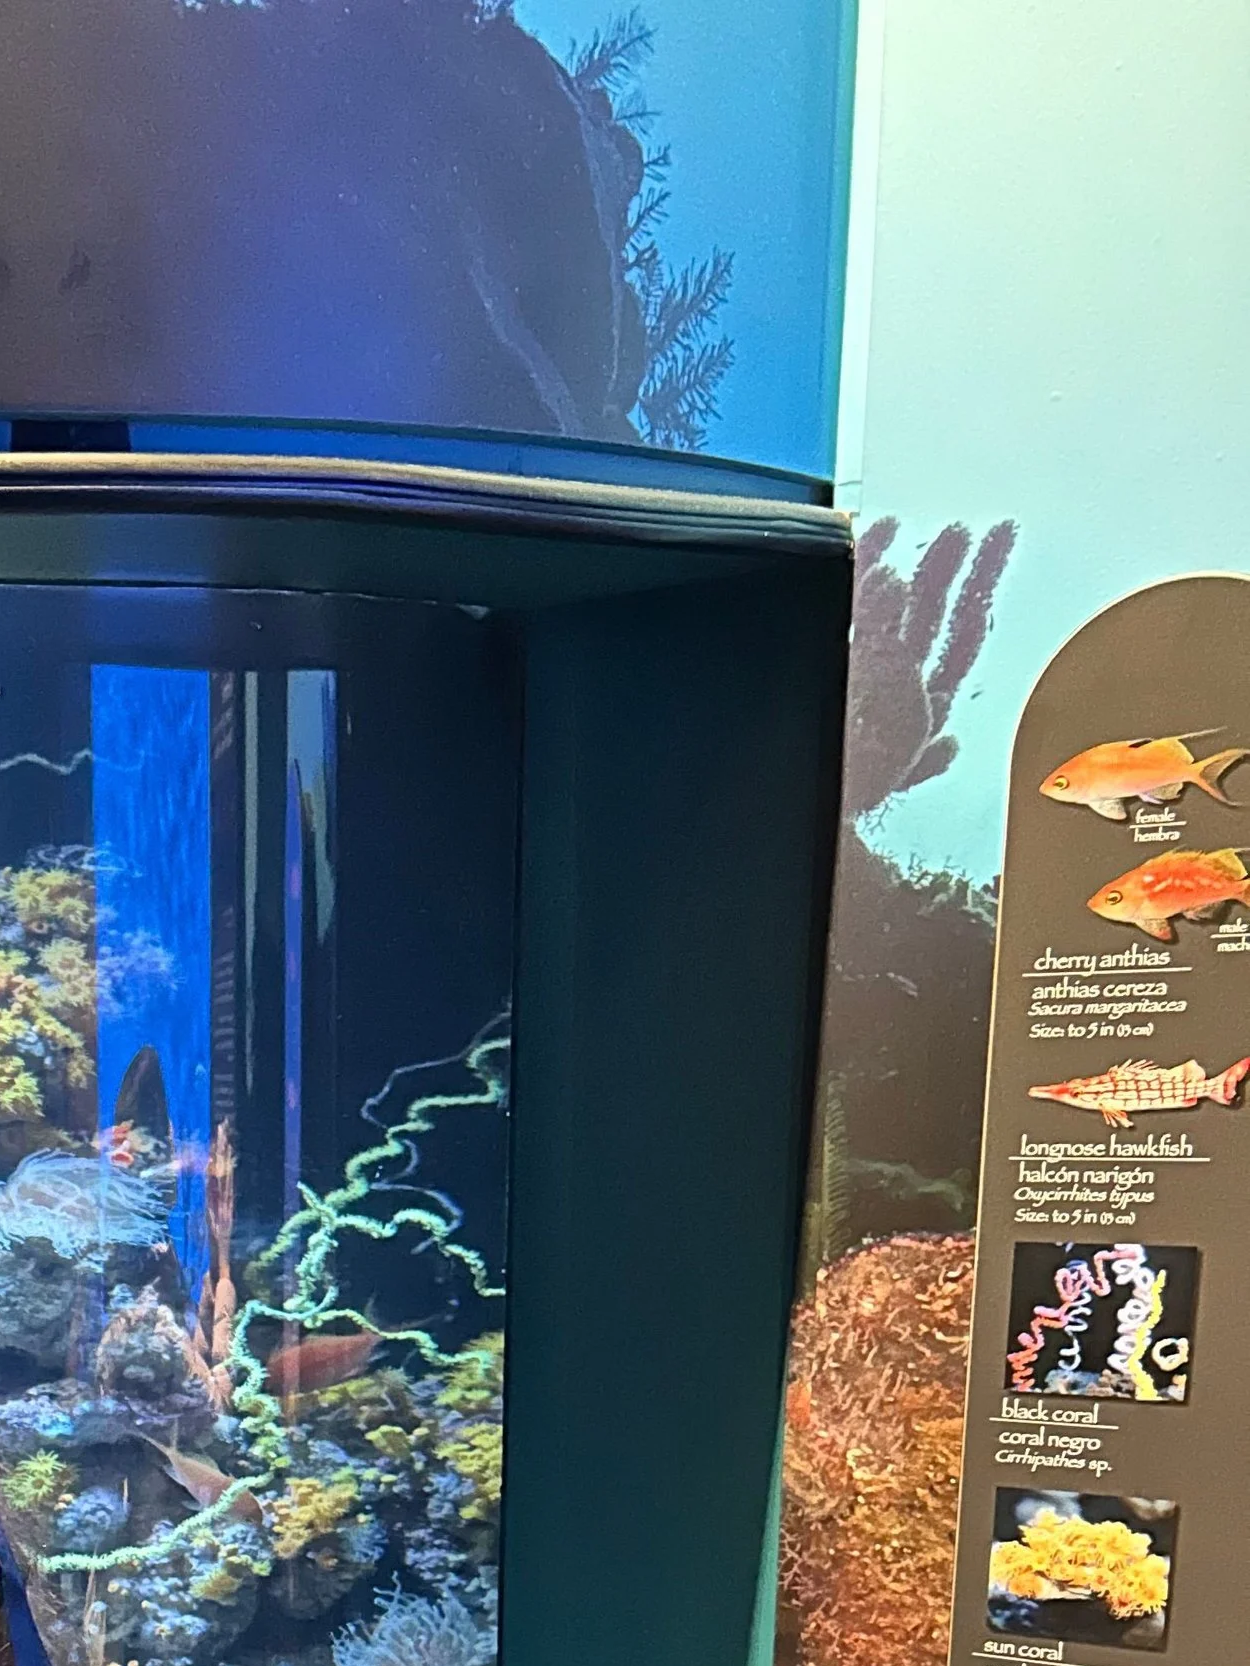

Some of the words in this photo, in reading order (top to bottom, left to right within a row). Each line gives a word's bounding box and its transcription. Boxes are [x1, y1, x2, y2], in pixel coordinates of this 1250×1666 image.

[1135, 806, 1176, 824] female
[1133, 826, 1181, 842] hembra
[1219, 917, 1249, 933] male
[1216, 935, 1250, 952] mach
[1034, 947, 1096, 977] cherry
[1099, 942, 1171, 968] anthias
[1031, 976, 1100, 999] anthias
[1103, 982, 1168, 997] cereza
[1027, 1001, 1083, 1016] Sacura
[1084, 998, 1188, 1020] margaritacea
[1029, 1023, 1065, 1038] Size:
[1067, 1024, 1086, 1037] to
[1086, 1022, 1098, 1038] 5
[1099, 1022, 1114, 1037] in
[1020, 1133, 1106, 1163] longnose
[1109, 1133, 1193, 1157] hawkfish
[1018, 1160, 1079, 1183] halcón
[1082, 1165, 1155, 1191] narigón
[1013, 1184, 1107, 1207] Oxycirrhites
[1109, 1188, 1155, 1210] typus
[1014, 1208, 1049, 1224] Size:
[1051, 1209, 1070, 1223] to
[1070, 1208, 1082, 1225] 5
[1083, 1208, 1097, 1224] in
[1115, 1211, 1136, 1225] cm)
[1001, 1397, 1049, 1420] black
[1051, 1403, 1099, 1424] coral
[998, 1425, 1045, 1446] coral
[1047, 1435, 1101, 1456] negro
[994, 1447, 1086, 1472] Cirrhipathes
[1088, 1460, 1113, 1478] sp.
[983, 1641, 1015, 1655] sun
[1017, 1640, 1064, 1661] coral
